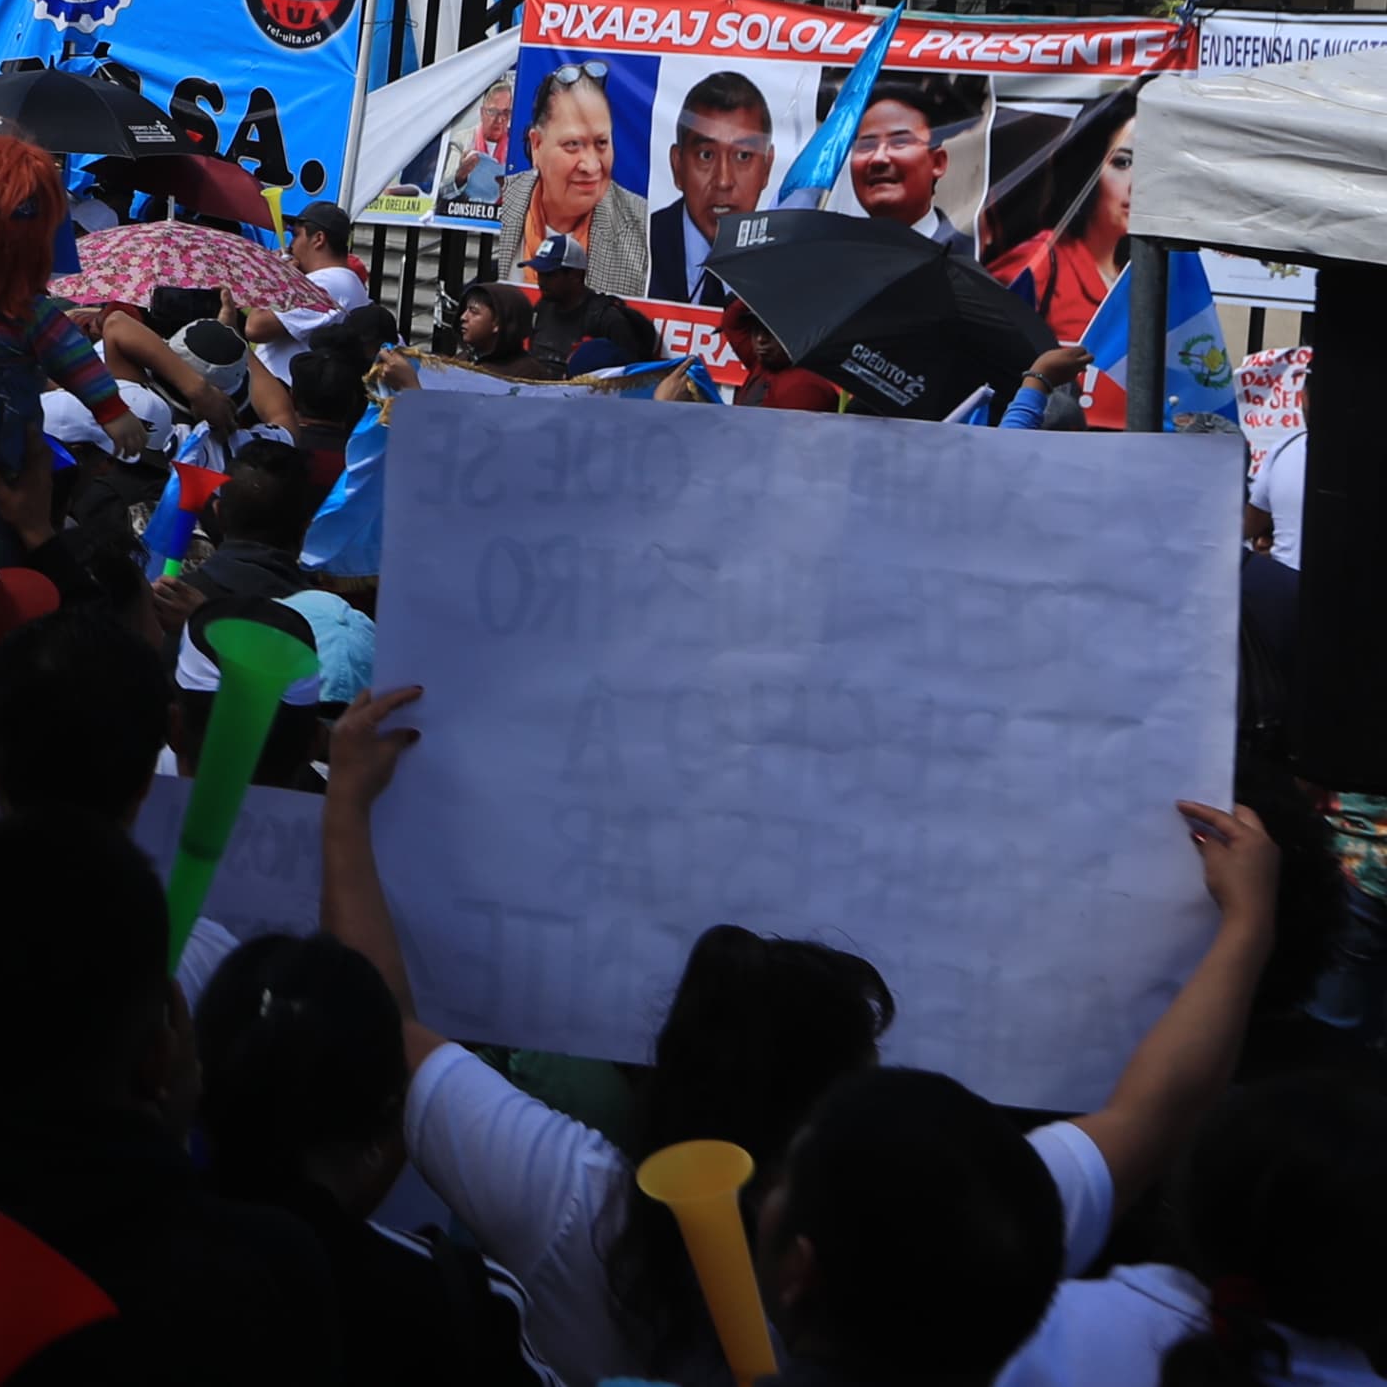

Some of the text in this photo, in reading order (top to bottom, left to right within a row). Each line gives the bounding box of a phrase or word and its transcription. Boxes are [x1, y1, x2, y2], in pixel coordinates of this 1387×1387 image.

[266, 23, 323, 45] rel-uita.org
[538, 2, 710, 48] PIXABAJ
[1200, 34, 1221, 67] EN
[1224, 35, 1293, 68] DEFENSA
[385, 198, 422, 213] ORELLANA
[447, 201, 495, 219] CONSUELO
[850, 342, 907, 386] CRÉDITO
